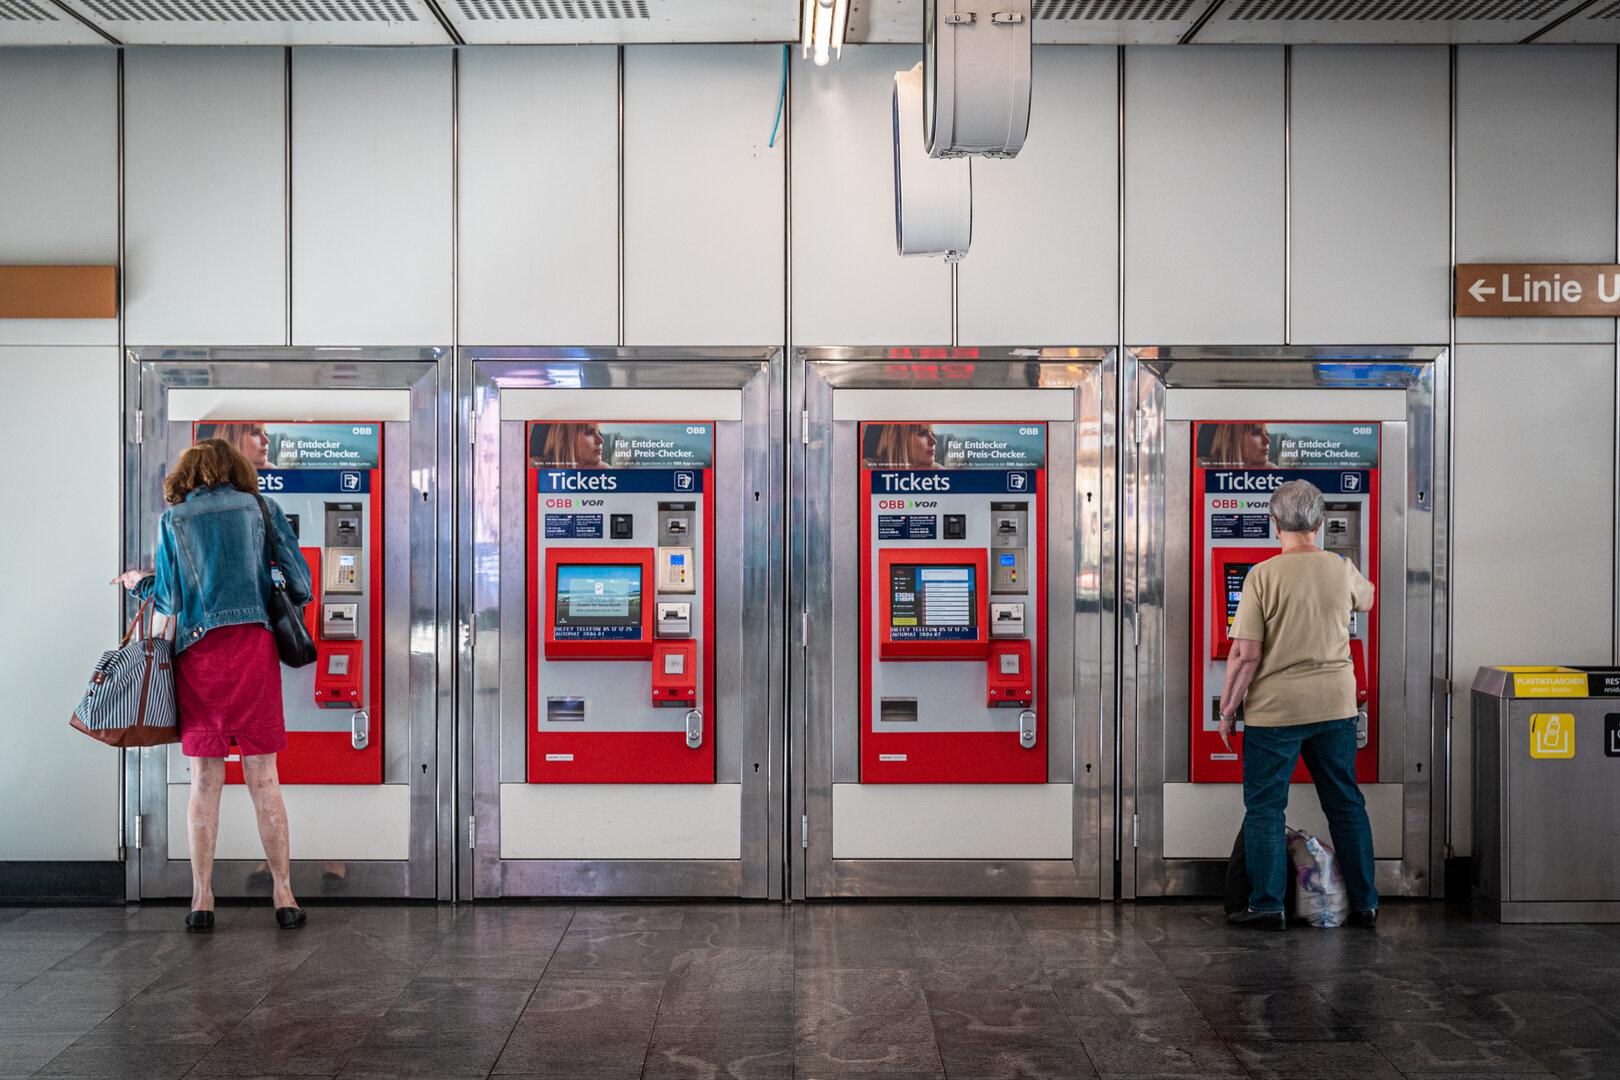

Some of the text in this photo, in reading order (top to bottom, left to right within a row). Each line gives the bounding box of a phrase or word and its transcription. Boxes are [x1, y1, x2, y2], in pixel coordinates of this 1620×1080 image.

[1502, 273, 1620, 303] Linie U
[281, 440, 341, 449] Für Entdecker
[615, 440, 675, 449] Für Entdecker
[948, 441, 1008, 449] Für Entdecker
[1281, 440, 1341, 449] Für Entdecker
[281, 449, 360, 458] und Preis-Checker.
[615, 449, 694, 458] und Preis-Checker.
[948, 450, 1027, 459] und Preis-Checker.
[1281, 449, 1360, 458] und Preis-Checker.
[548, 472, 617, 490] Tickets
[881, 473, 951, 491] Tickets
[1215, 472, 1284, 490] Tickets
[1517, 677, 1584, 685] PLASTIKFLASCHEN
